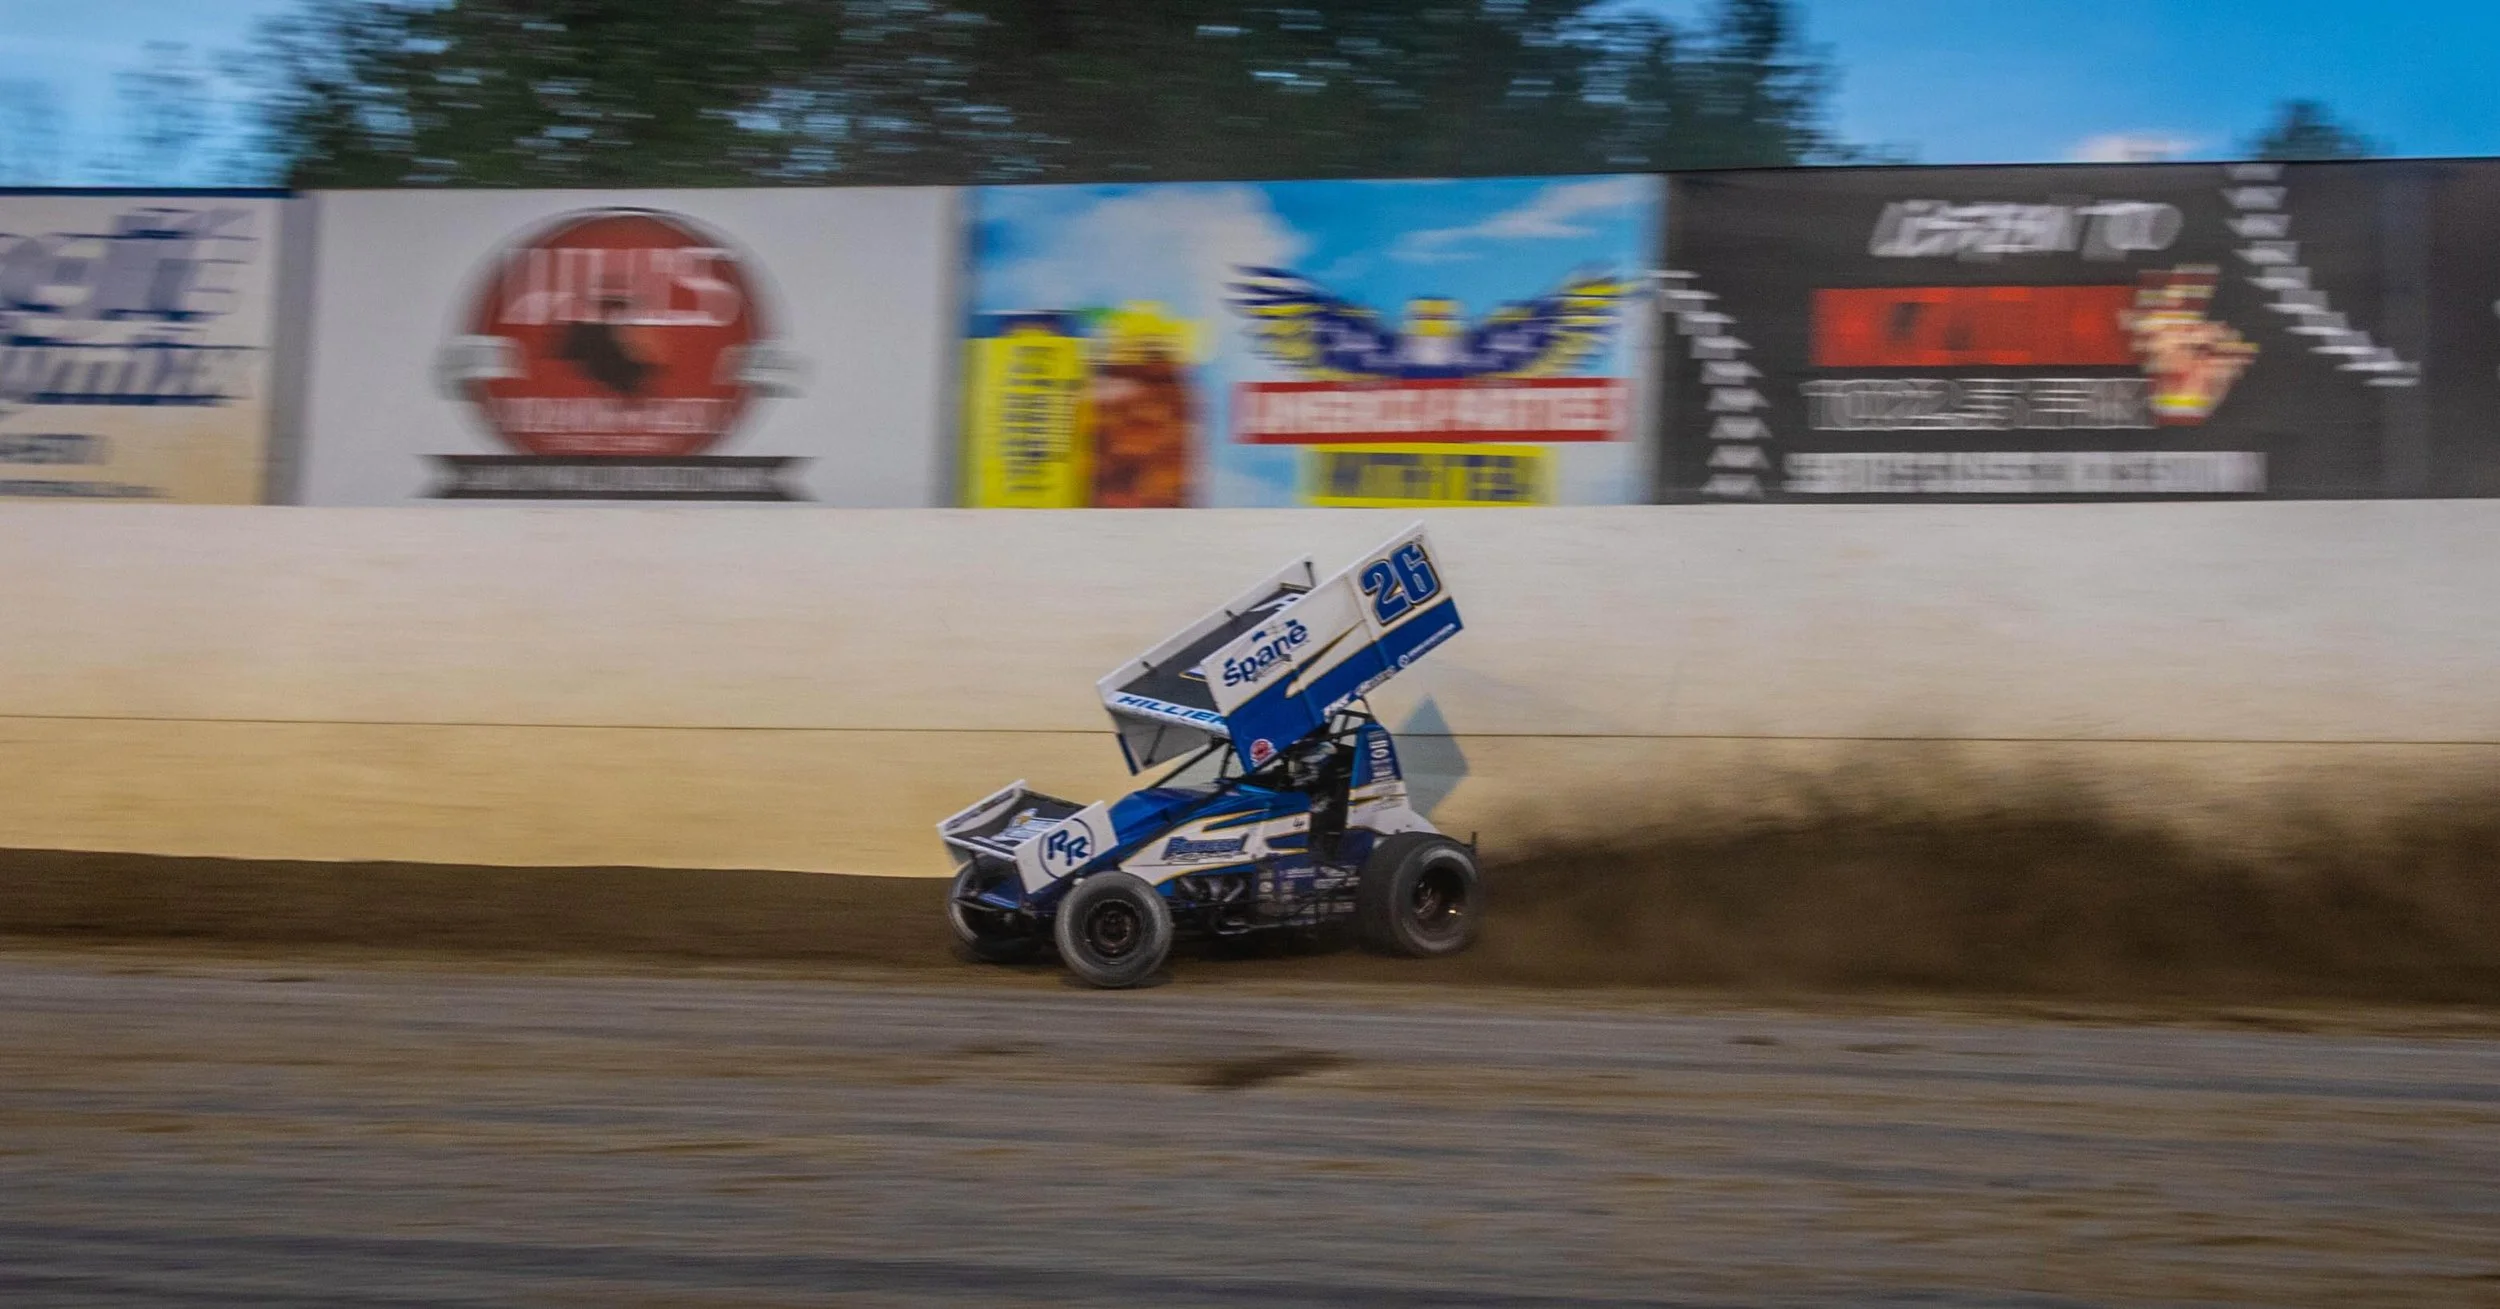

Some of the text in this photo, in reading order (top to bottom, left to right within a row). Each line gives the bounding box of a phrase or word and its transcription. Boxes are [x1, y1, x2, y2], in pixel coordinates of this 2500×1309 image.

[1358, 540, 1442, 627] 26
[1222, 620, 1309, 687] spane
[1047, 829, 1089, 867] RR
